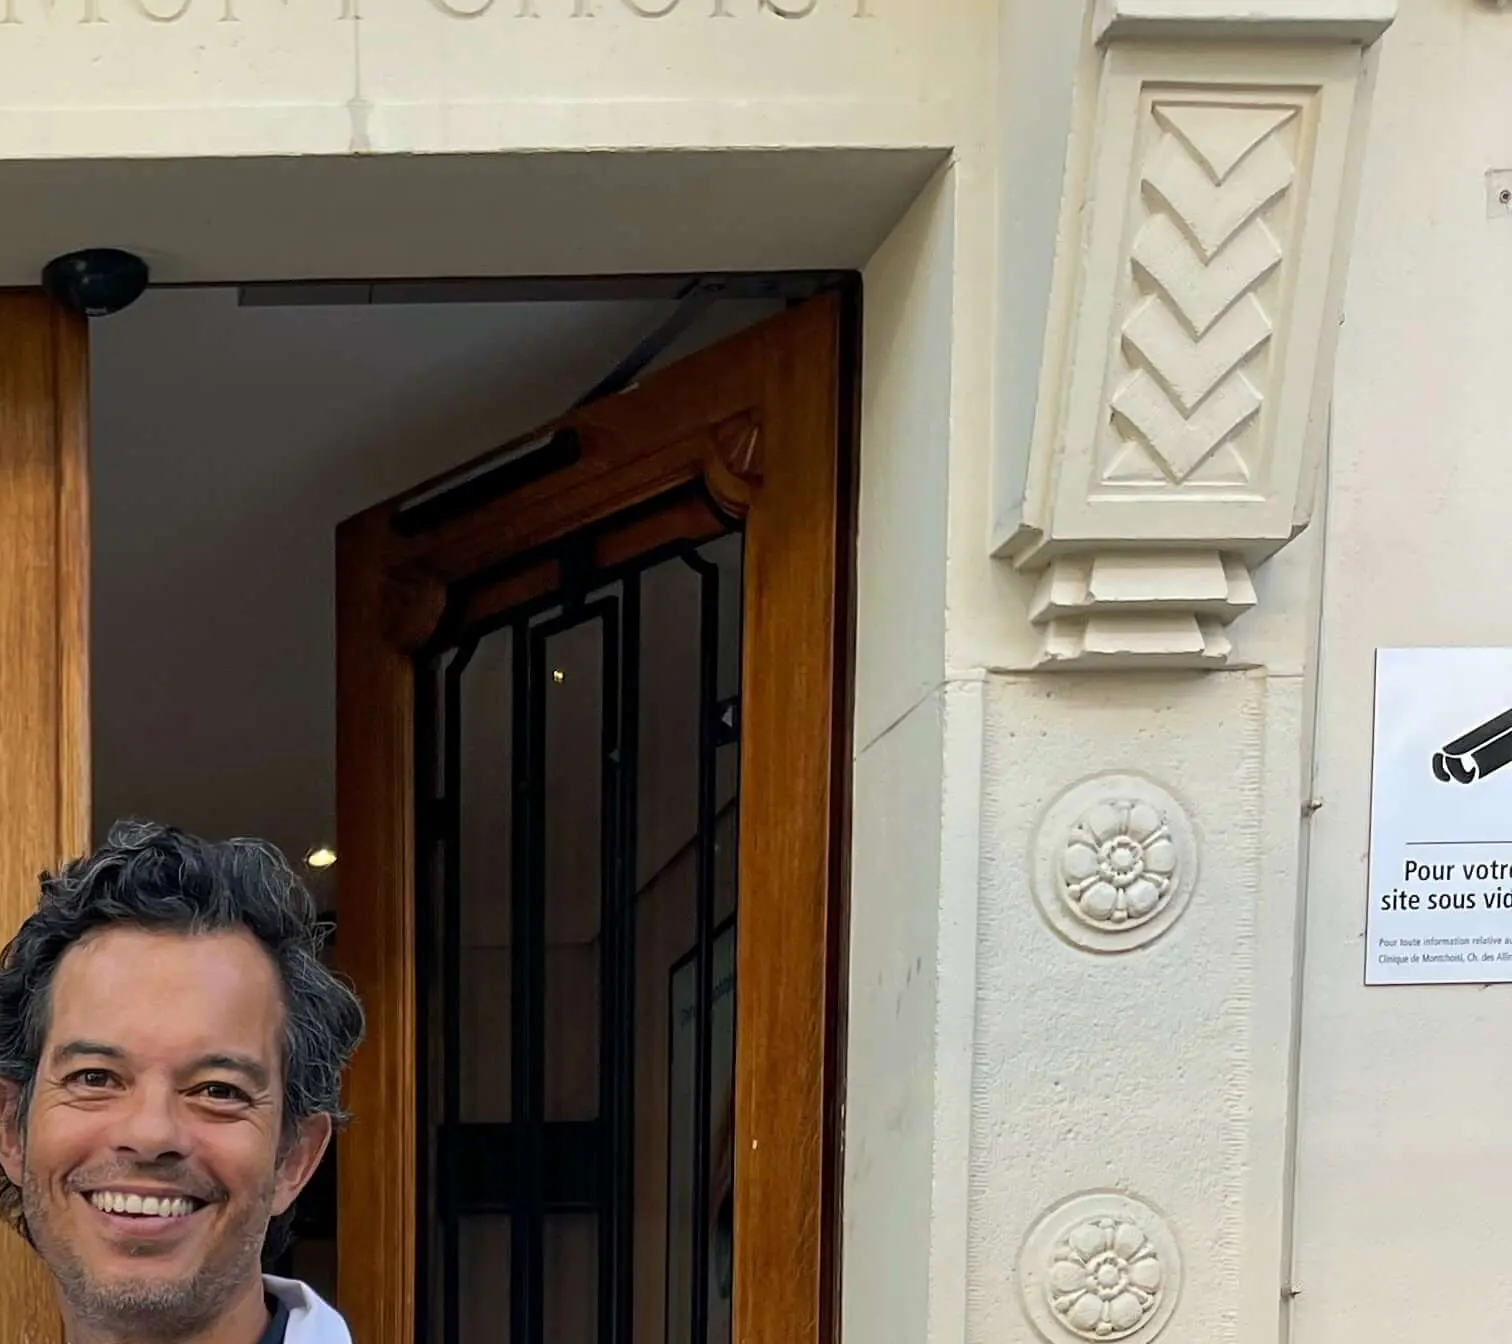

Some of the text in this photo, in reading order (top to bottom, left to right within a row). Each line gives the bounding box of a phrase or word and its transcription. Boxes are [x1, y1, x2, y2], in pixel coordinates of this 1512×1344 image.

[1405, 860, 1512, 881] Pour votr
[1381, 888, 1420, 910] site
[1427, 893, 1476, 910] sous
